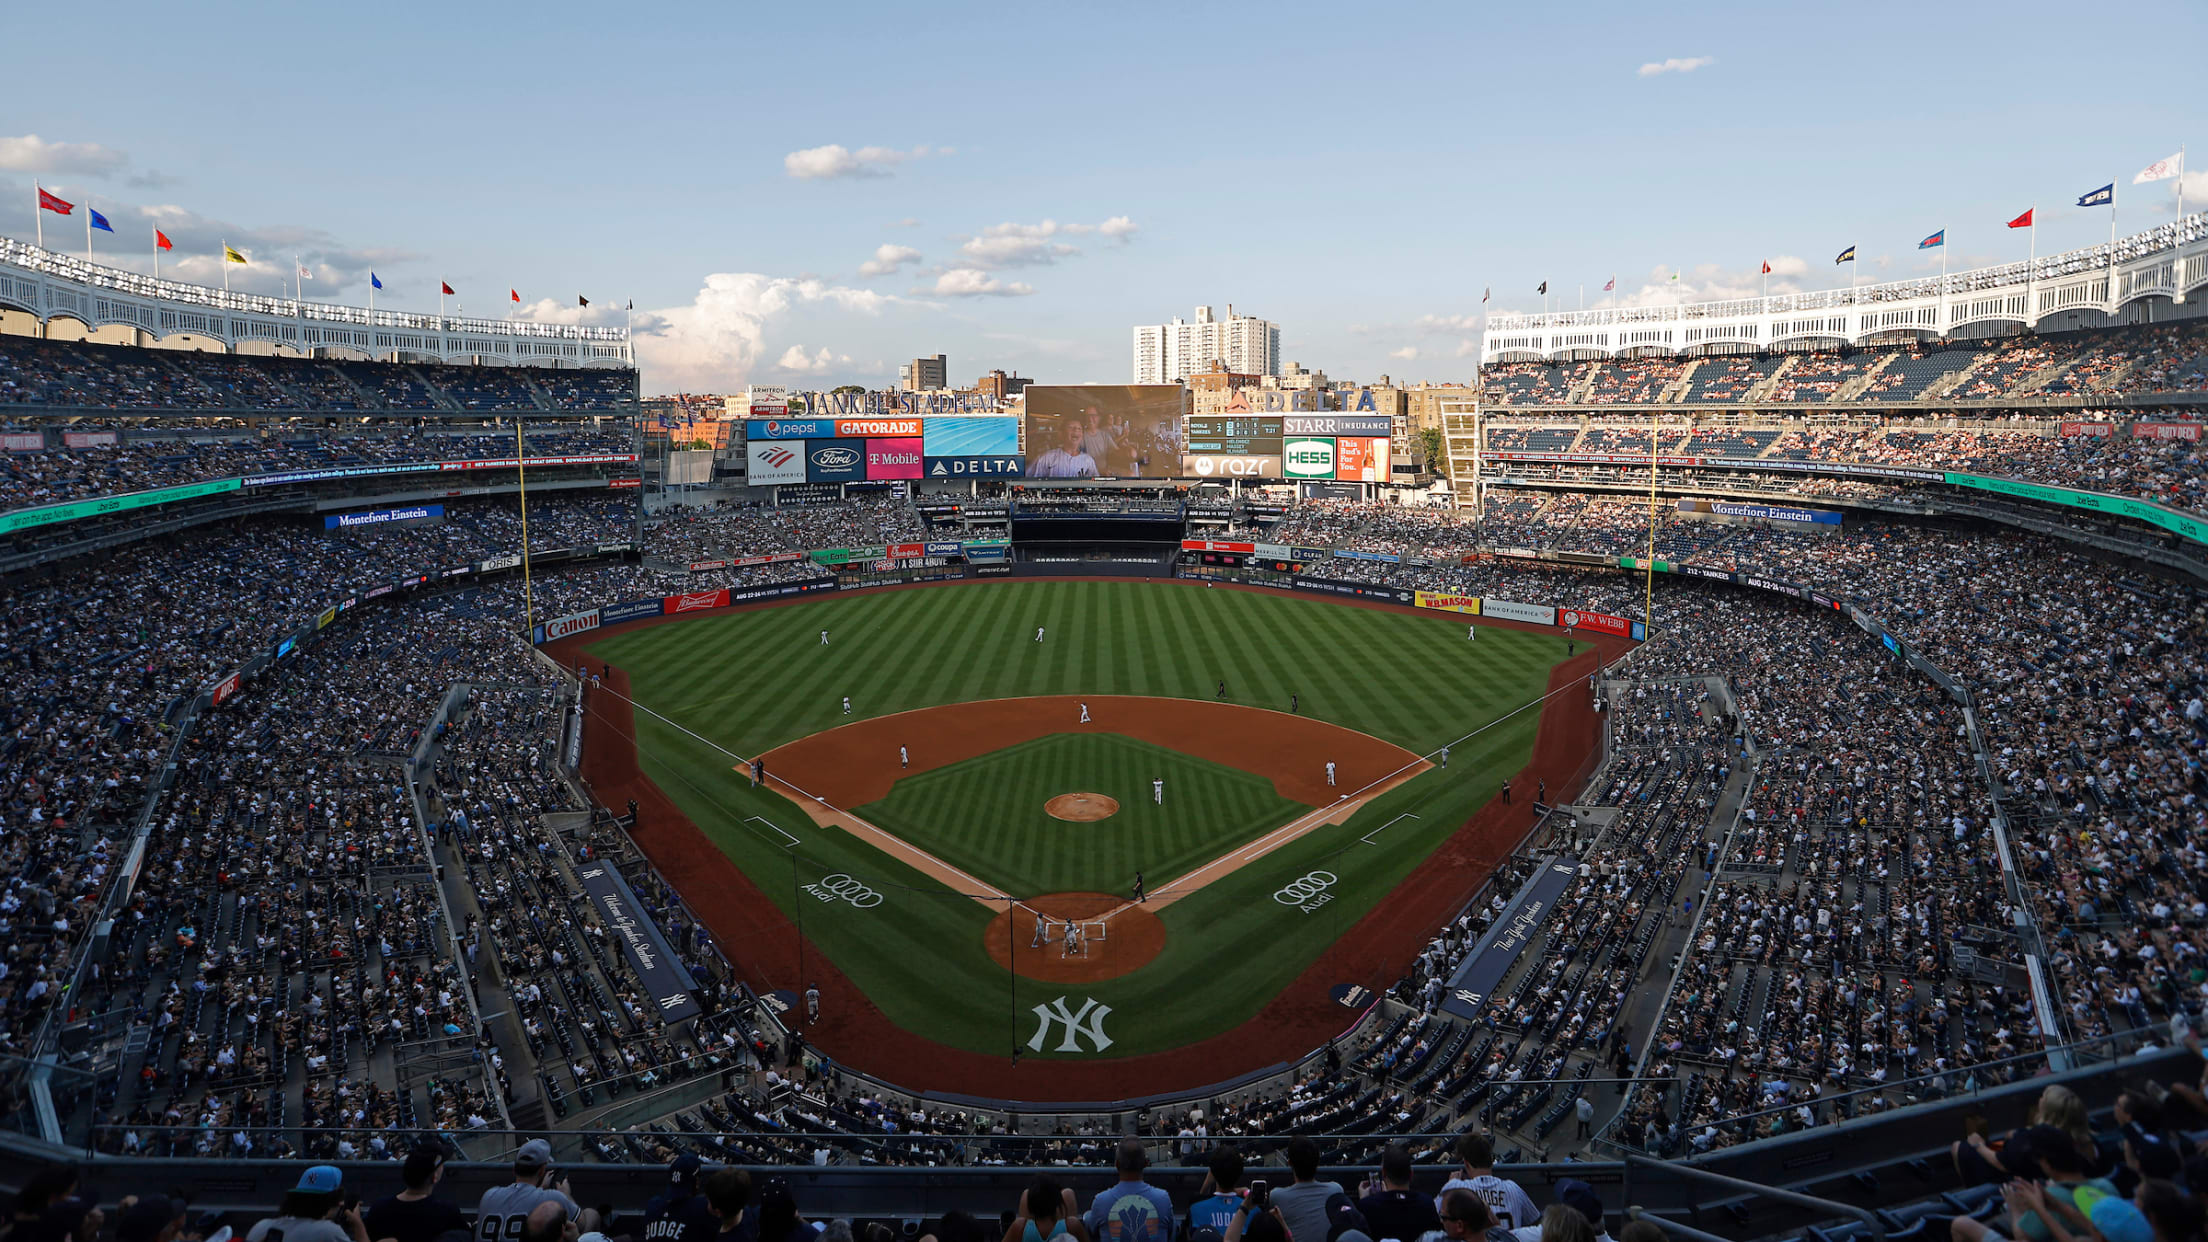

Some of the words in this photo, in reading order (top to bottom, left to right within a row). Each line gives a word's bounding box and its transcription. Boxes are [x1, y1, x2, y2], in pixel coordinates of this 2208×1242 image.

[899, 393, 995, 414] STADIUM
[1265, 390, 1376, 412] DELTA
[782, 422, 816, 438] pepsi
[840, 422, 917, 434] GATORADE
[1284, 419, 1337, 433] STARR
[2157, 426, 2178, 440] PARTY
[2178, 426, 2196, 440] DECK
[820, 450, 852, 464] Ford
[882, 453, 920, 465] Mobile
[1288, 452, 1330, 464] HESS
[953, 460, 1019, 473] DELTA
[1219, 458, 1270, 475] razr
[339, 512, 389, 526] Montefiore
[391, 508, 428, 520] Einstein
[1711, 503, 1766, 518] Montefiore
[1768, 507, 1812, 521] Einstein
[488, 558, 513, 570] ORIS
[902, 559, 907, 569] A
[908, 558, 924, 569] SUB
[925, 558, 948, 567] ABOVE
[1702, 570, 1729, 580] YANKEES
[1748, 578, 1761, 587] AUG
[1762, 580, 1779, 591] 22-24
[1786, 586, 1800, 597] WSH
[603, 606, 634, 618] Montefiore
[635, 603, 658, 612] Einstein
[680, 598, 715, 607] Budweiser
[1426, 600, 1440, 608] W.B.
[1441, 598, 1473, 608] MASON
[547, 614, 598, 638] Canon
[1580, 614, 1596, 624] F.W.
[1598, 616, 1624, 629] WEBB
[218, 678, 235, 700] AVIS
[800, 884, 836, 903] Audi
[602, 892, 624, 920] Welcome
[1300, 892, 1335, 914] Audi
[1521, 901, 1544, 926] Yankees
[611, 919, 644, 944] Yankee
[1504, 915, 1527, 940] York
[1493, 936, 1516, 952] New
[632, 942, 655, 970] Stadium
[1026, 995, 1114, 1053] NY
[480, 1213, 528, 1242] 99
[646, 1221, 686, 1240] JUDGE
